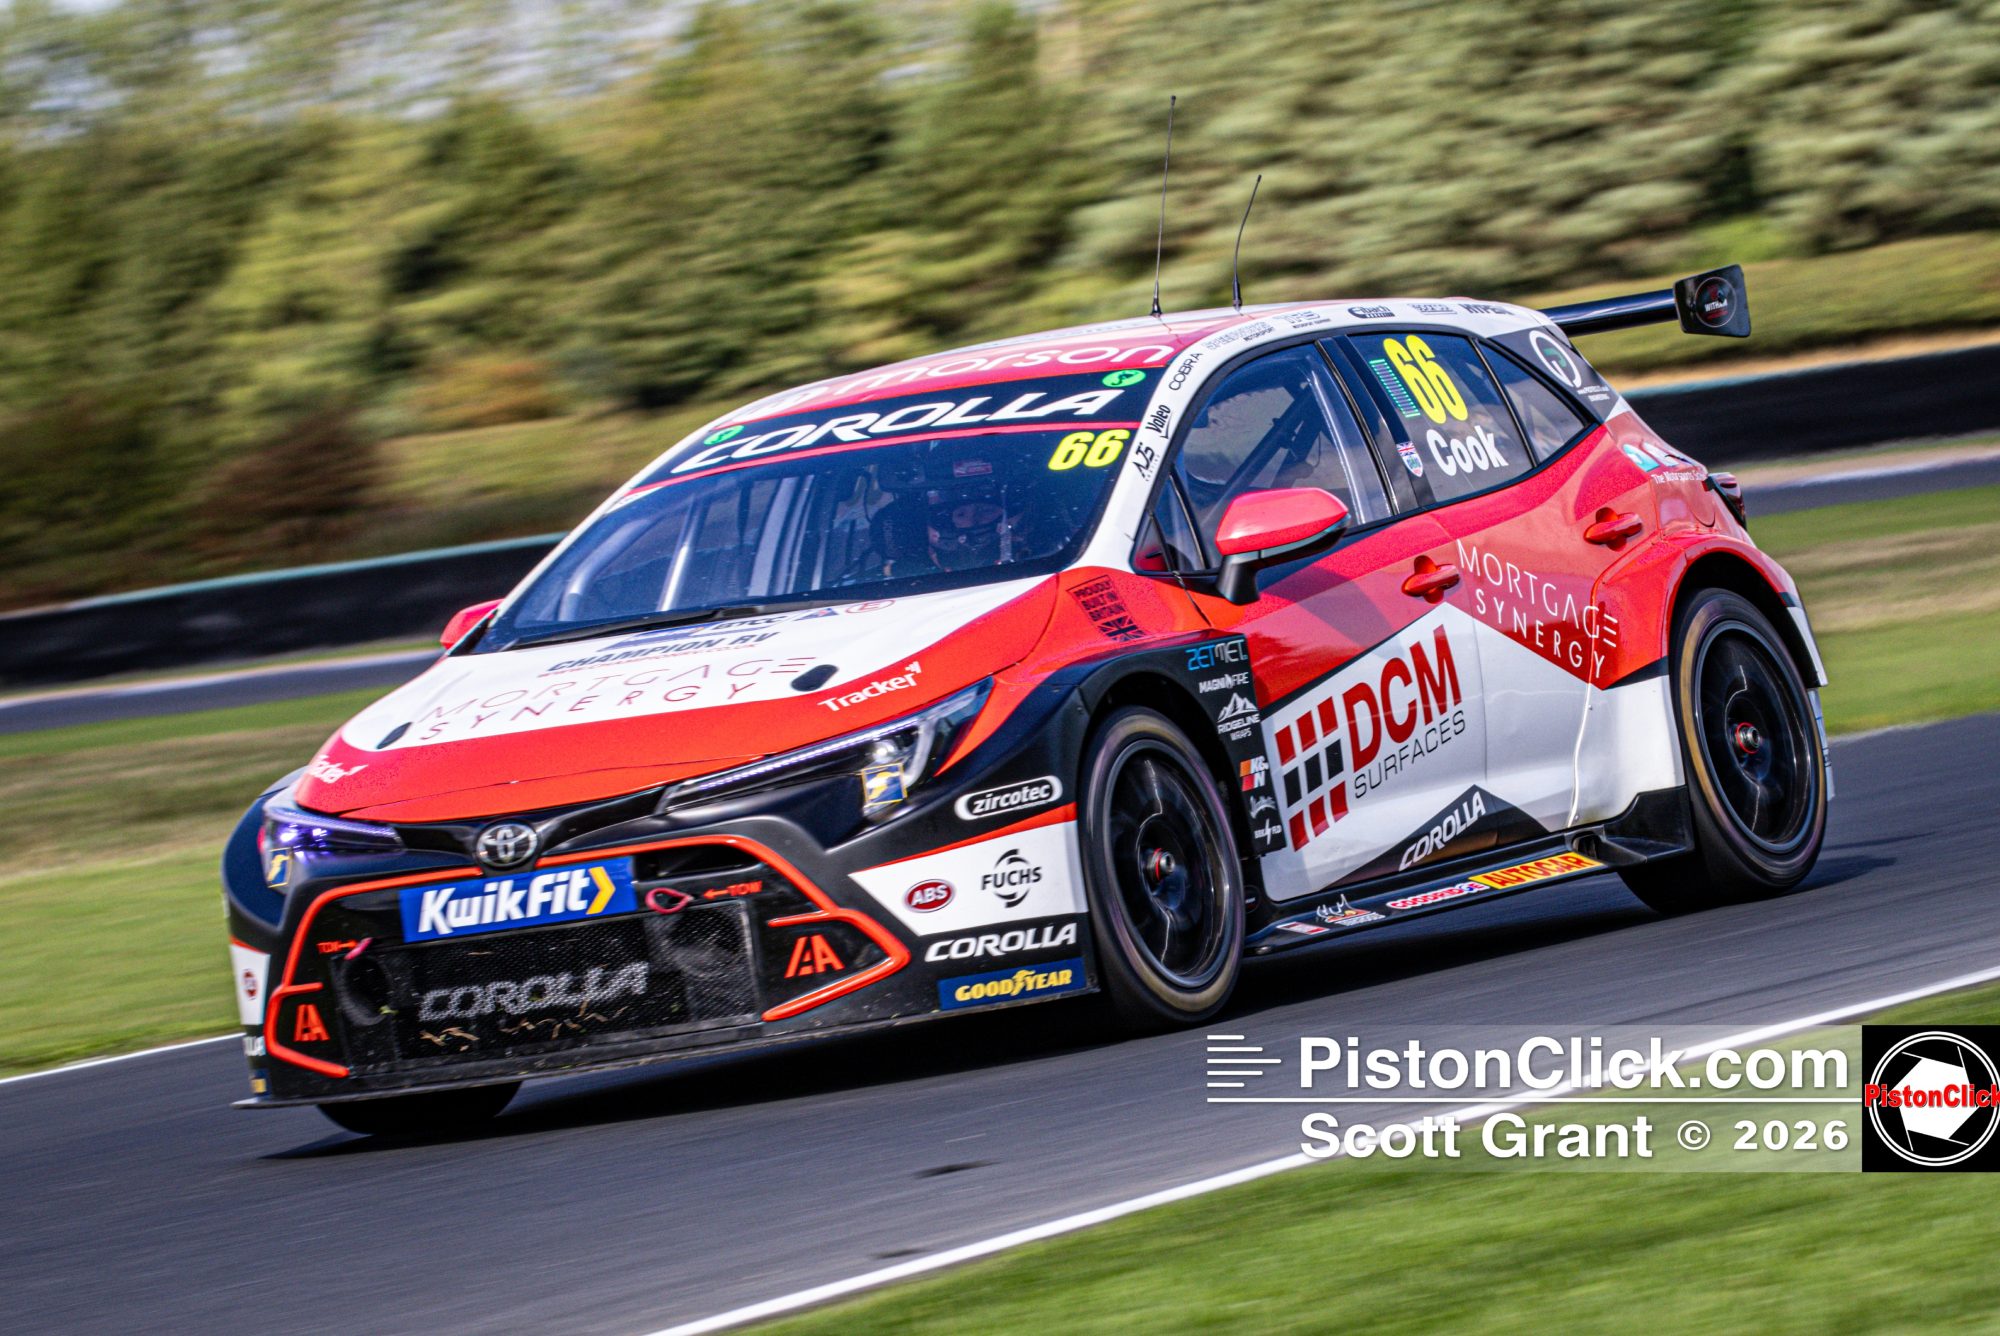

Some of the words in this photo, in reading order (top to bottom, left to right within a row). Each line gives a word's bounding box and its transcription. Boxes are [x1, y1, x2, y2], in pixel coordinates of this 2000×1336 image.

[833, 344, 1174, 396] morson
[1168, 352, 1204, 391] COBRA
[1383, 335, 1468, 424] 66
[670, 389, 1125, 474] COROLLA
[1145, 404, 1171, 434] Valeo
[1048, 429, 1130, 471] 66
[1426, 425, 1508, 476] Cook
[1457, 539, 1618, 648] MORTGAGE
[548, 638, 724, 671] CHAMPION
[730, 631, 781, 645] RV
[1476, 588, 1605, 679] SYNERGY
[418, 657, 817, 723] MORTGAGE
[817, 673, 919, 712] Tracker
[1342, 623, 1462, 773] DCM
[420, 683, 756, 740] SYNERGY
[1217, 712, 1261, 735] RIDGELINE
[1230, 727, 1252, 741] WRAPS
[1354, 709, 1466, 799] SURFACES
[972, 781, 1051, 815] zircotec
[1399, 790, 1487, 872] COROLLA
[726, 880, 763, 896] TOW
[981, 866, 1043, 891] FUCHS
[1488, 854, 1596, 888] AUTOCAR
[910, 883, 948, 907] ABS
[924, 922, 1078, 963] COROLLA
[418, 960, 650, 1023] COROLLA
[955, 968, 1073, 1002] GOODYEAR
